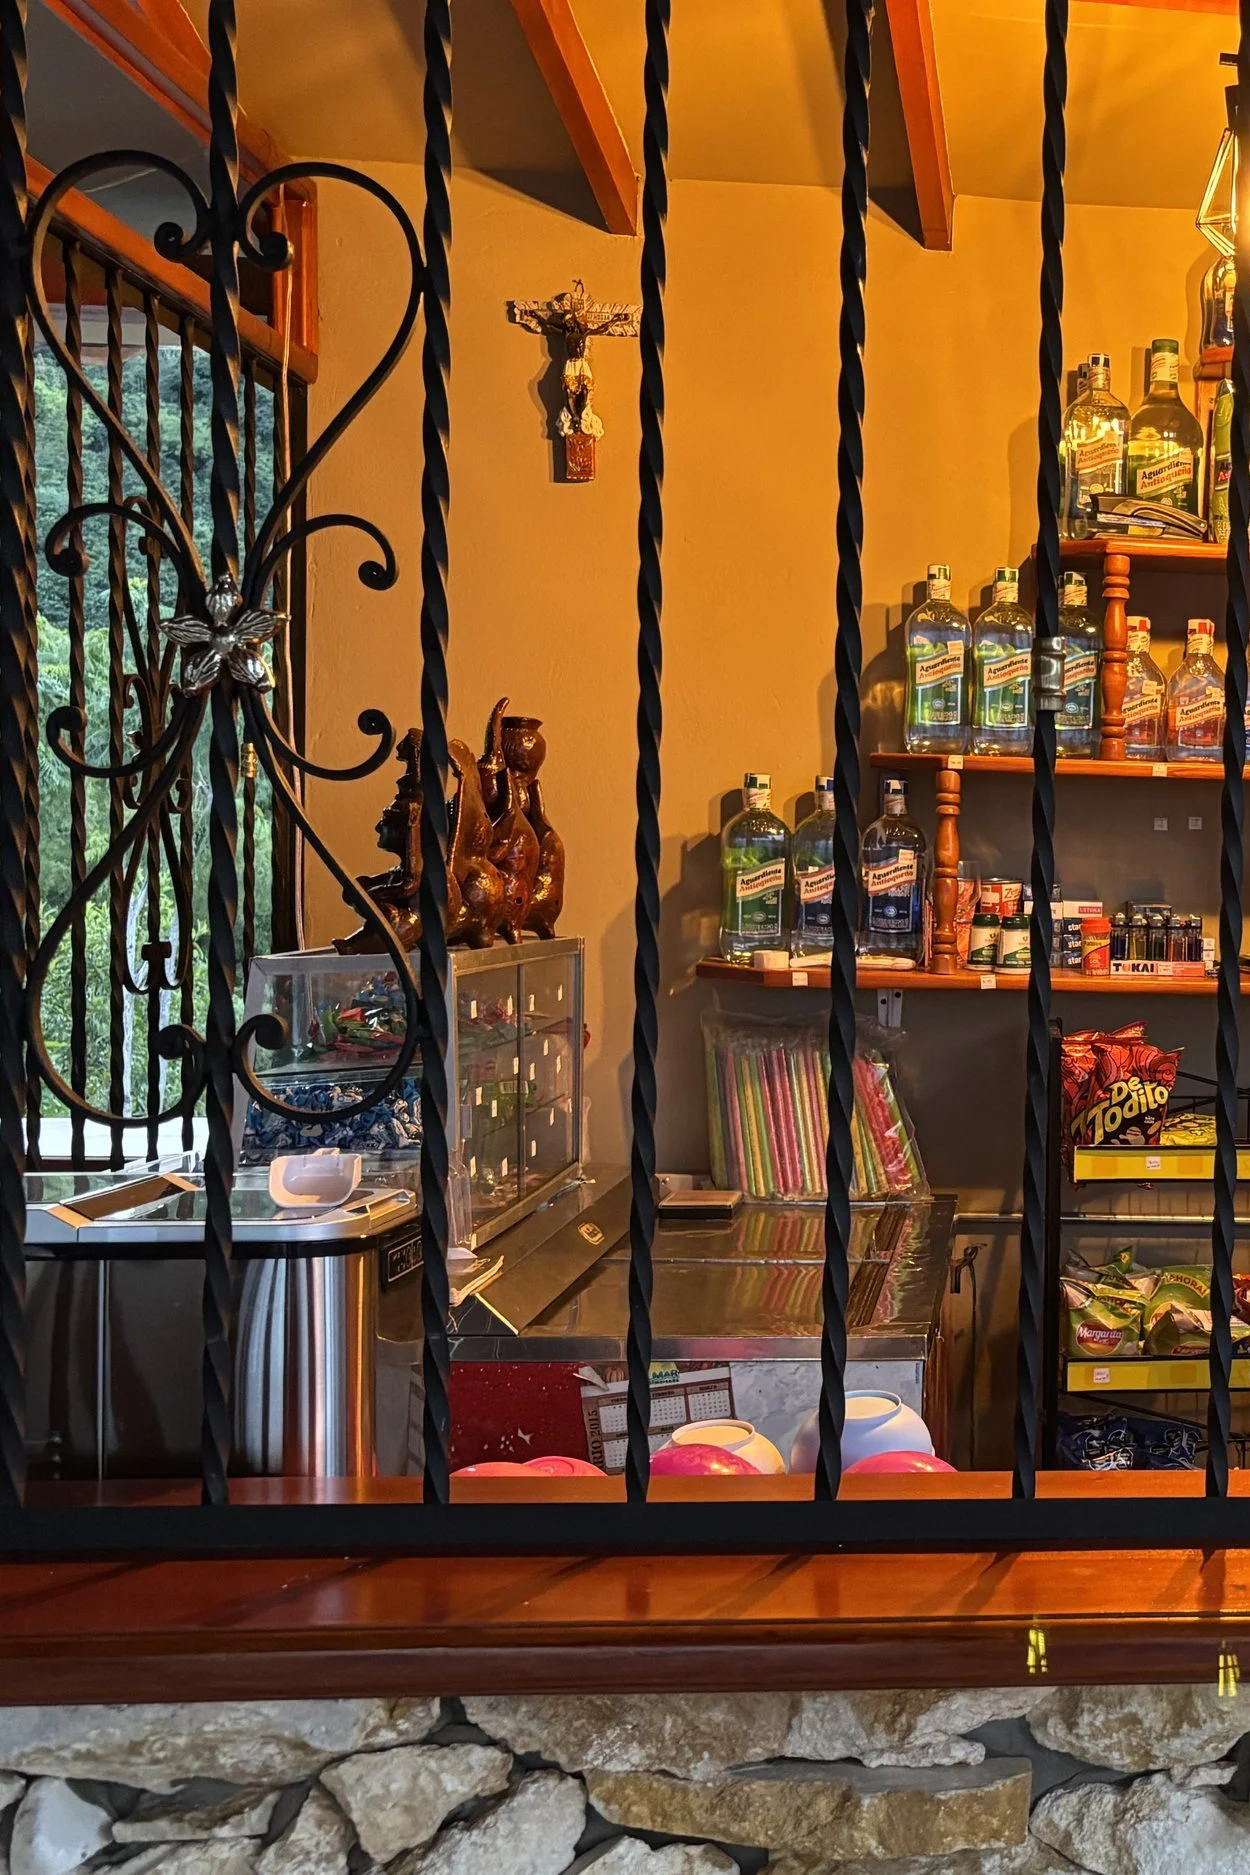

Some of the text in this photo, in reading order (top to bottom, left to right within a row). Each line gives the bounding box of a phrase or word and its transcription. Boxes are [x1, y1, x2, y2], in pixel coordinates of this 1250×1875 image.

[919, 656, 961, 673] Aguardiente
[987, 658, 1029, 675] Aguardiente
[1122, 698, 1158, 714] guardiente
[740, 868, 782, 885] Aguardiente
[872, 864, 914, 881] Aguardiente
[1112, 963, 1155, 973] TOKAI
[1110, 1076, 1143, 1105] De
[1087, 1082, 1169, 1145] Todito
[1078, 1326, 1122, 1341] Margarita
[587, 1410, 600, 1437] 2015
